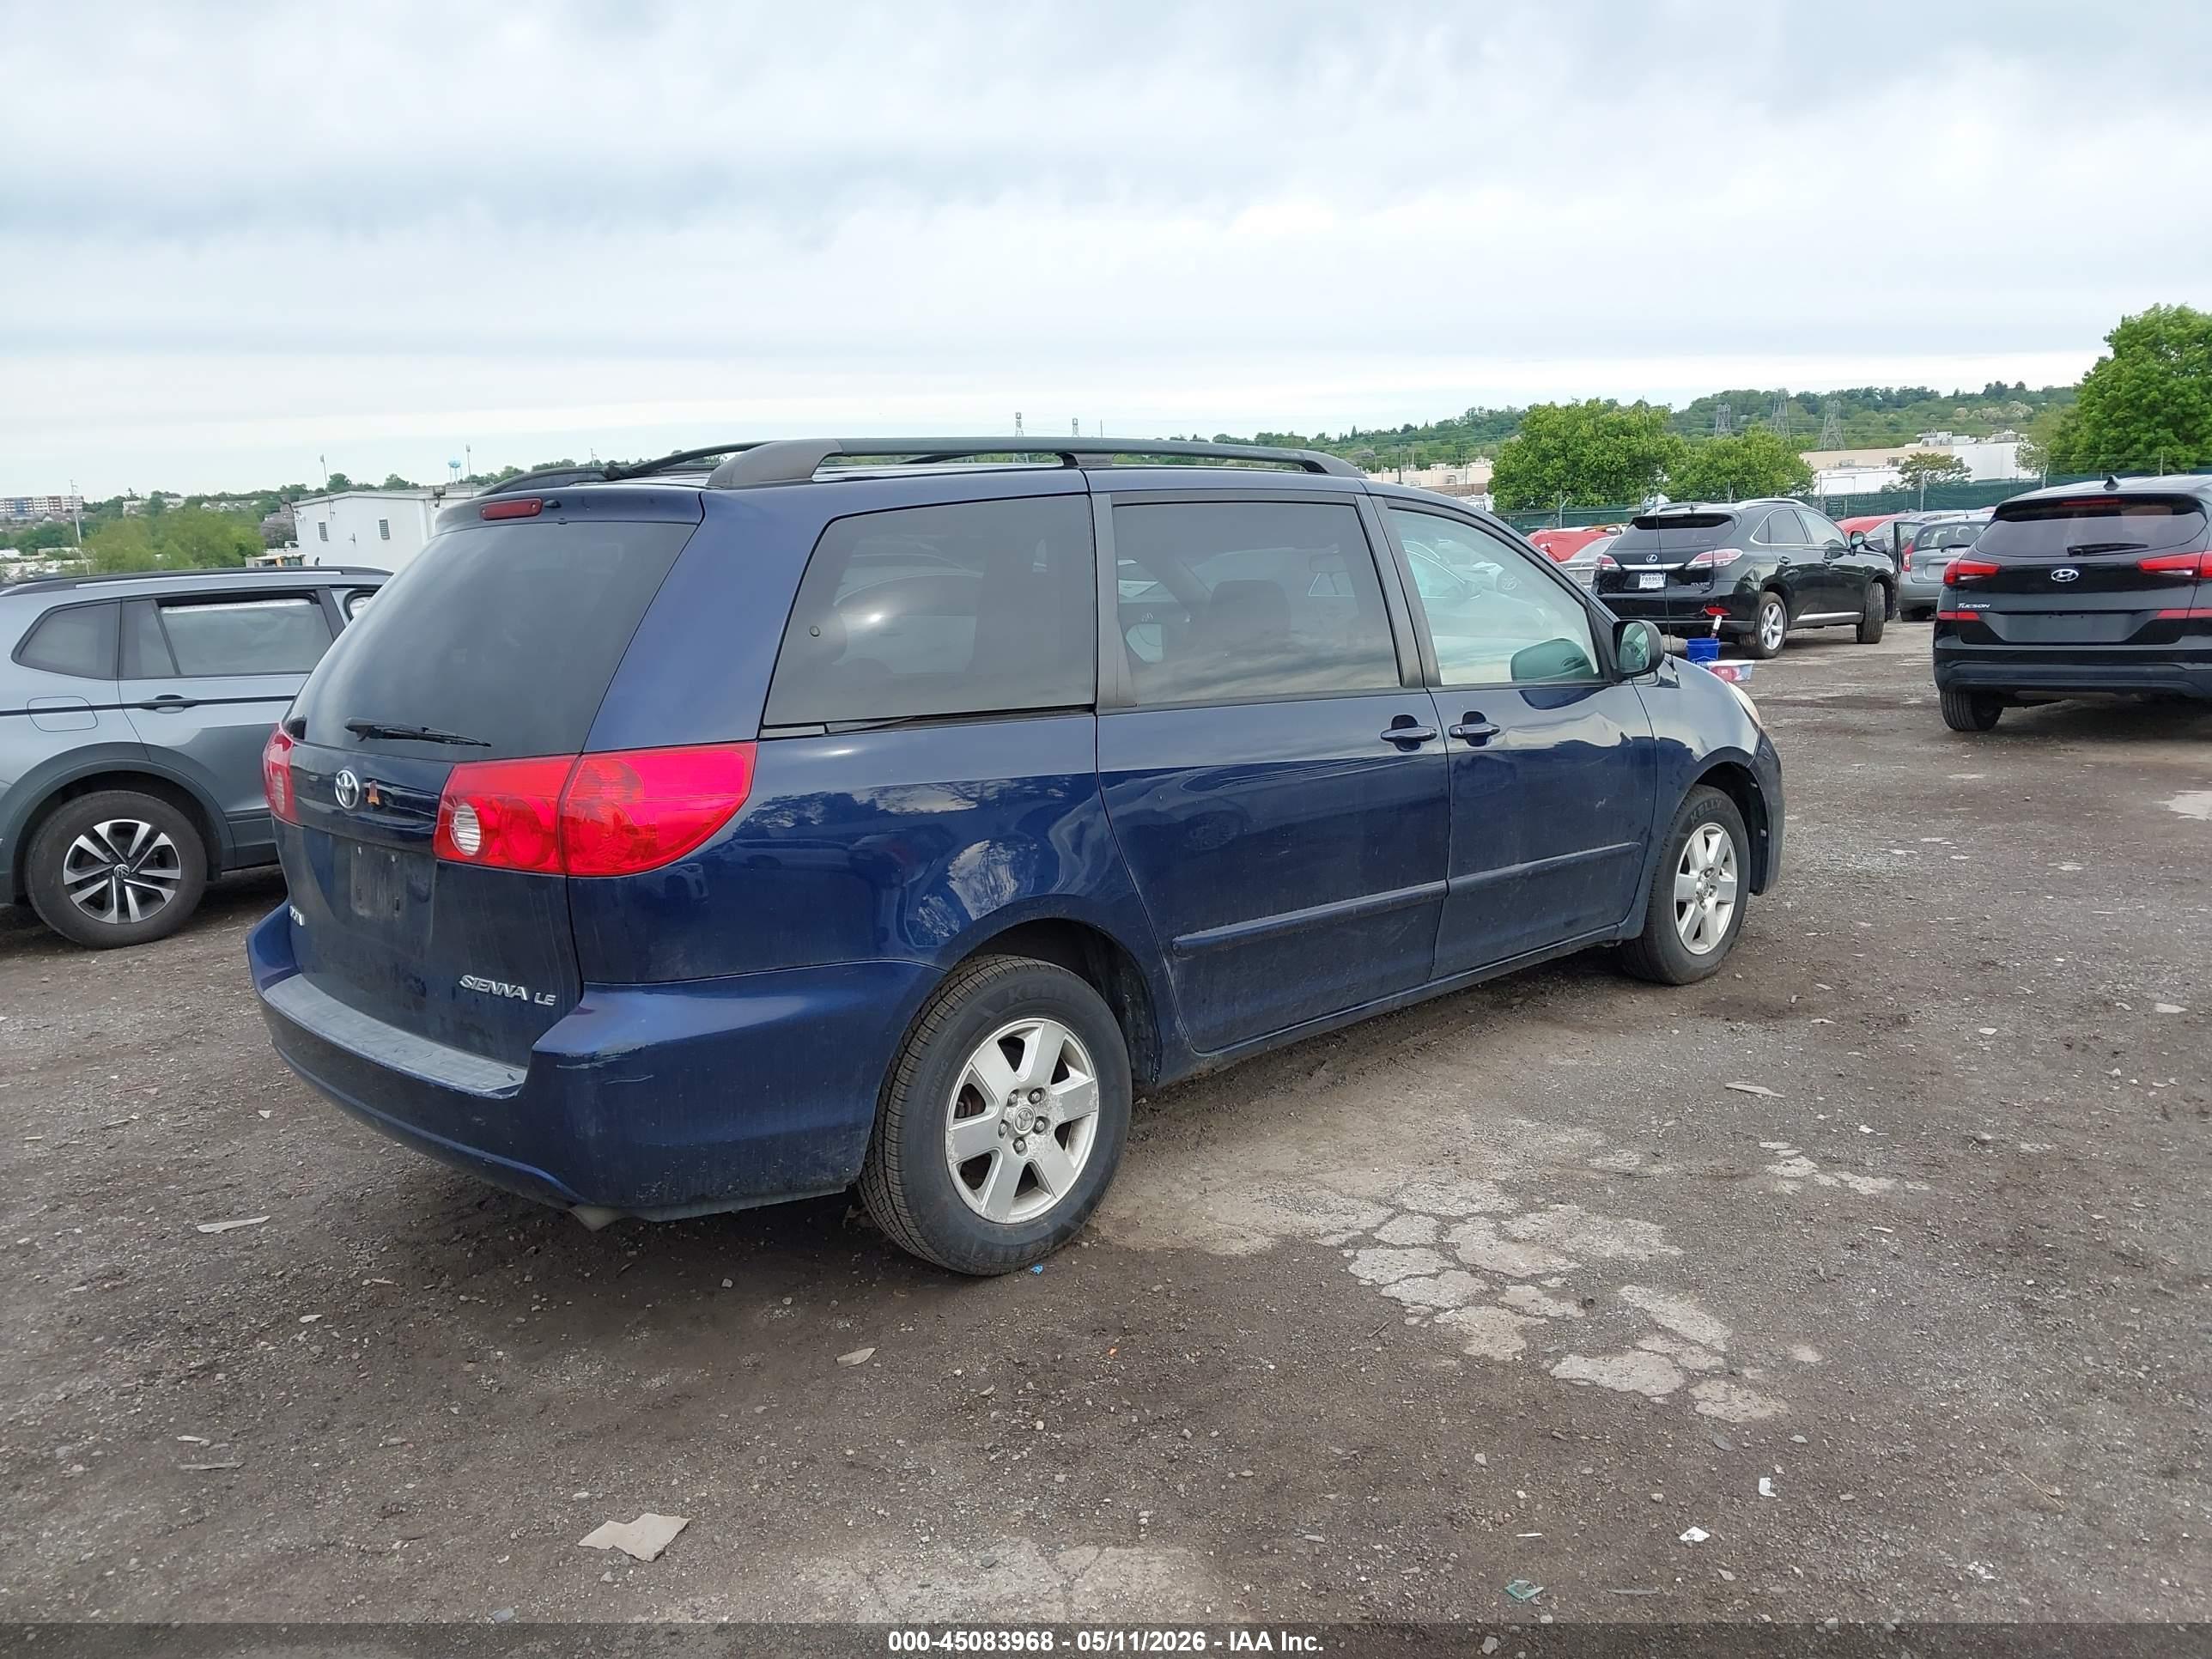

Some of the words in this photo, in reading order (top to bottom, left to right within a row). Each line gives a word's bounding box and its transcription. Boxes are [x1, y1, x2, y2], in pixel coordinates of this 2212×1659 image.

[1690, 799, 1722, 824] KELLY
[459, 975, 528, 1001] SIENNA
[534, 992, 556, 1006] LE
